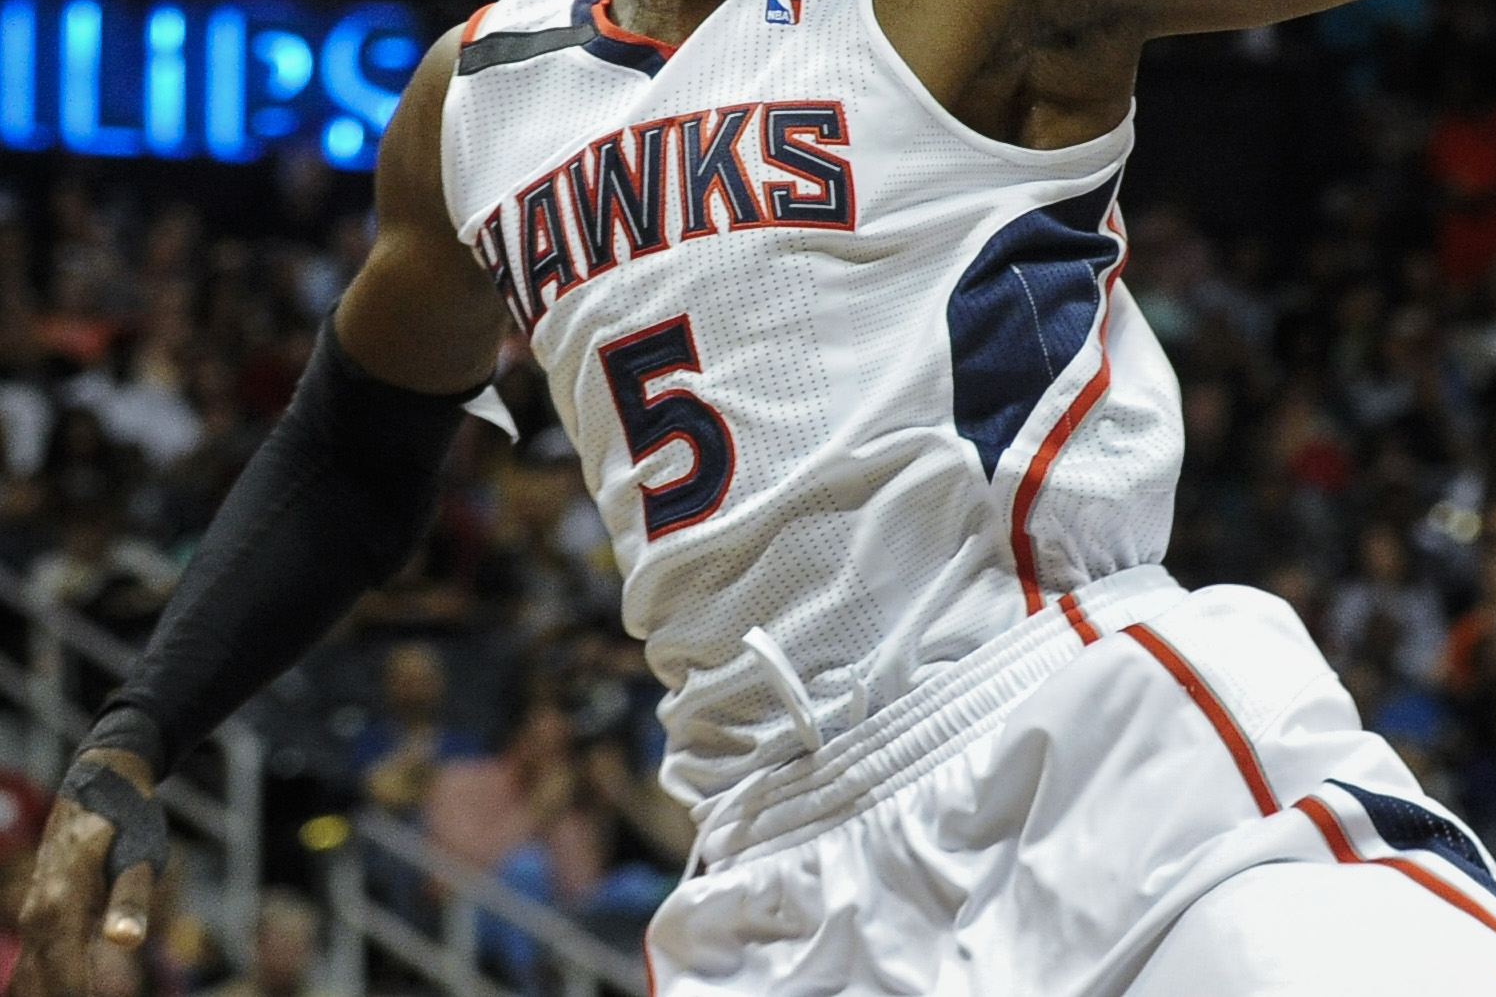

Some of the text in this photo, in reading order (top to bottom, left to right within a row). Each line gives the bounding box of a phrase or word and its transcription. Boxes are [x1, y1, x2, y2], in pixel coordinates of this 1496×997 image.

[767, 9, 789, 21] NBA
[476, 99, 856, 336] HAWKS
[598, 312, 736, 543] 5
